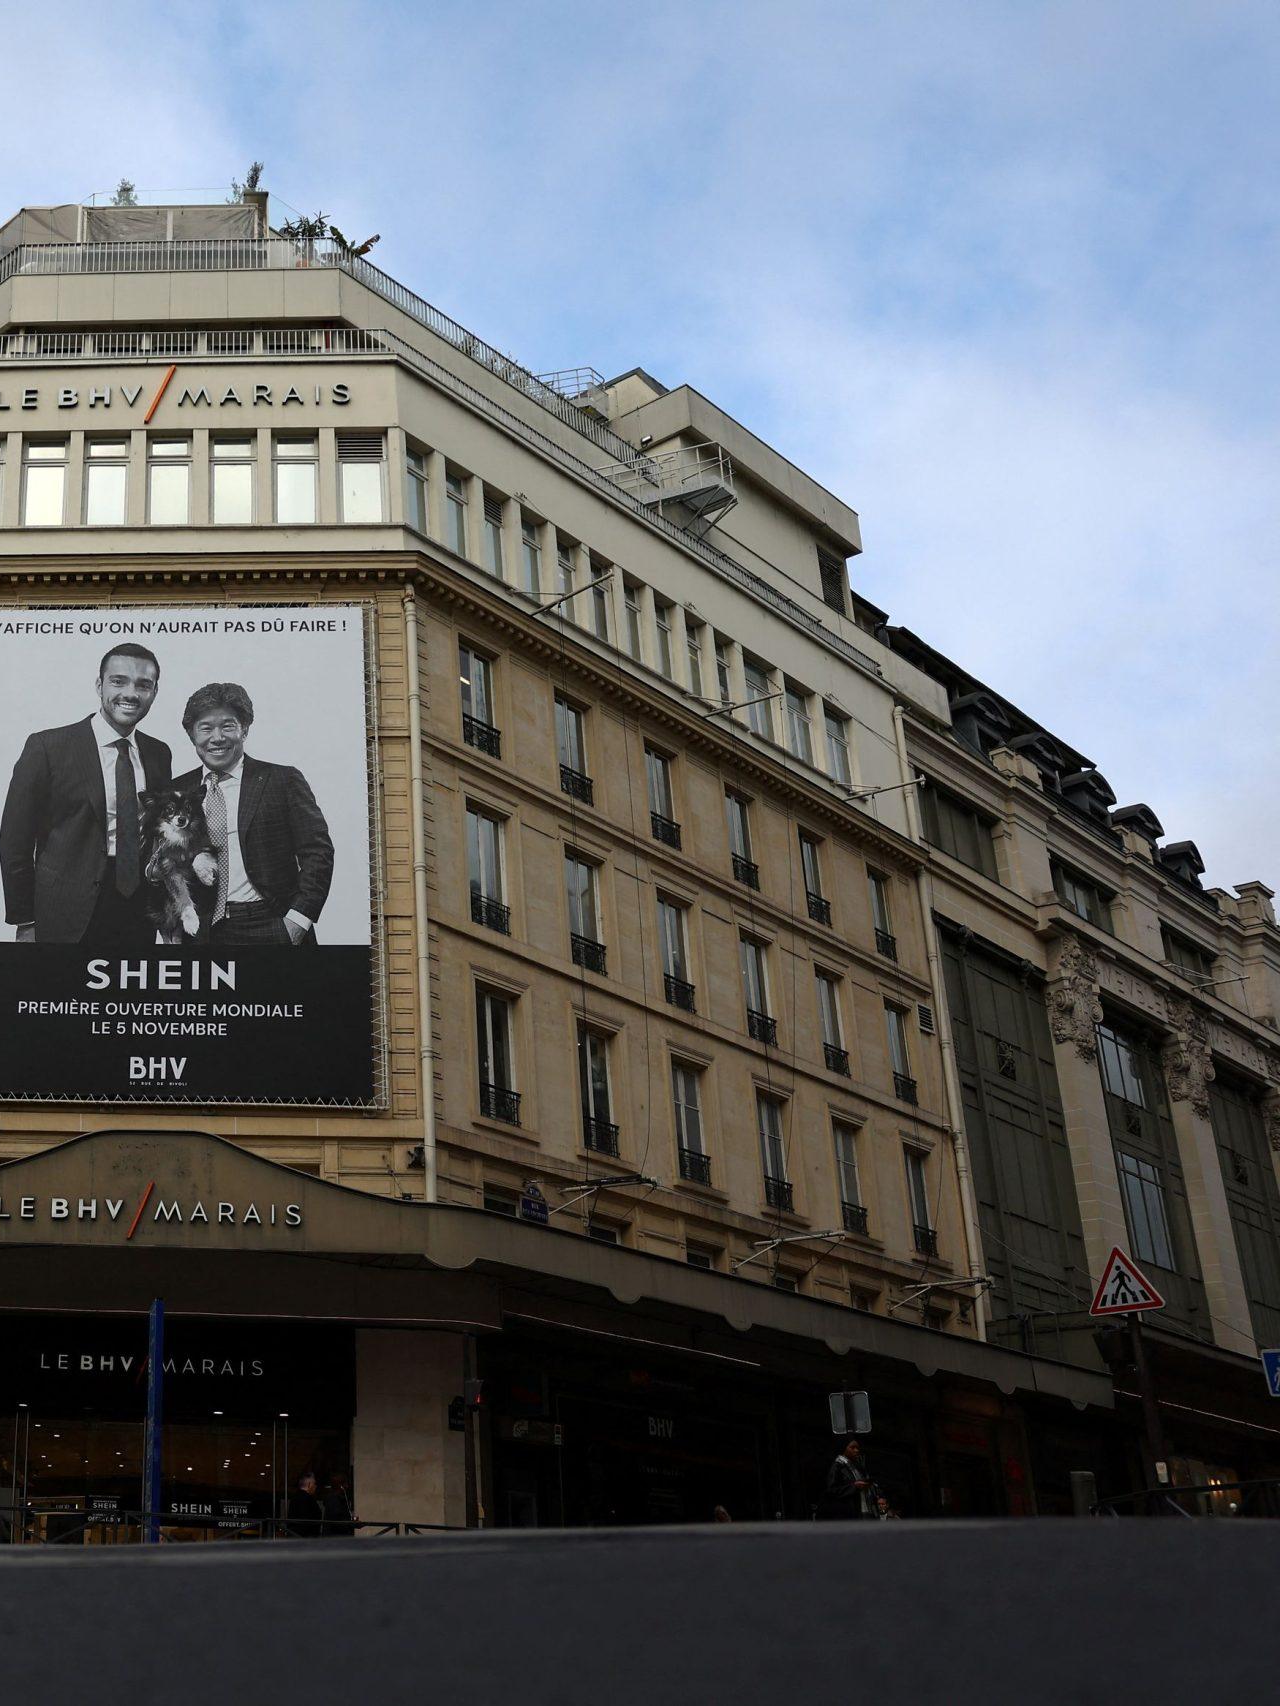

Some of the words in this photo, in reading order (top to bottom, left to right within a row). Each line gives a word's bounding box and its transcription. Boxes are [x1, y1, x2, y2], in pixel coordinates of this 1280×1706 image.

[224, 621, 257, 633] PAS
[261, 617, 286, 632] DÛ
[290, 620, 337, 632] FAIRE
[86, 958, 236, 991] SHEIN
[18, 998, 100, 1015] PREMIÈRE
[105, 1002, 207, 1017] OUVERTURE
[212, 1003, 304, 1018] MONDIALE
[91, 1021, 111, 1034] LE
[116, 1021, 126, 1035] 5
[132, 1021, 228, 1036] NOVEMBRE
[129, 1056, 187, 1080] BHV
[50, 1197, 124, 1221] BHV
[153, 1199, 303, 1227] MARAIS
[40, 1352, 70, 1370] LE
[79, 1354, 134, 1371] BHV
[648, 1415, 673, 1439] BHV
[171, 1503, 212, 1514] SHEIN
